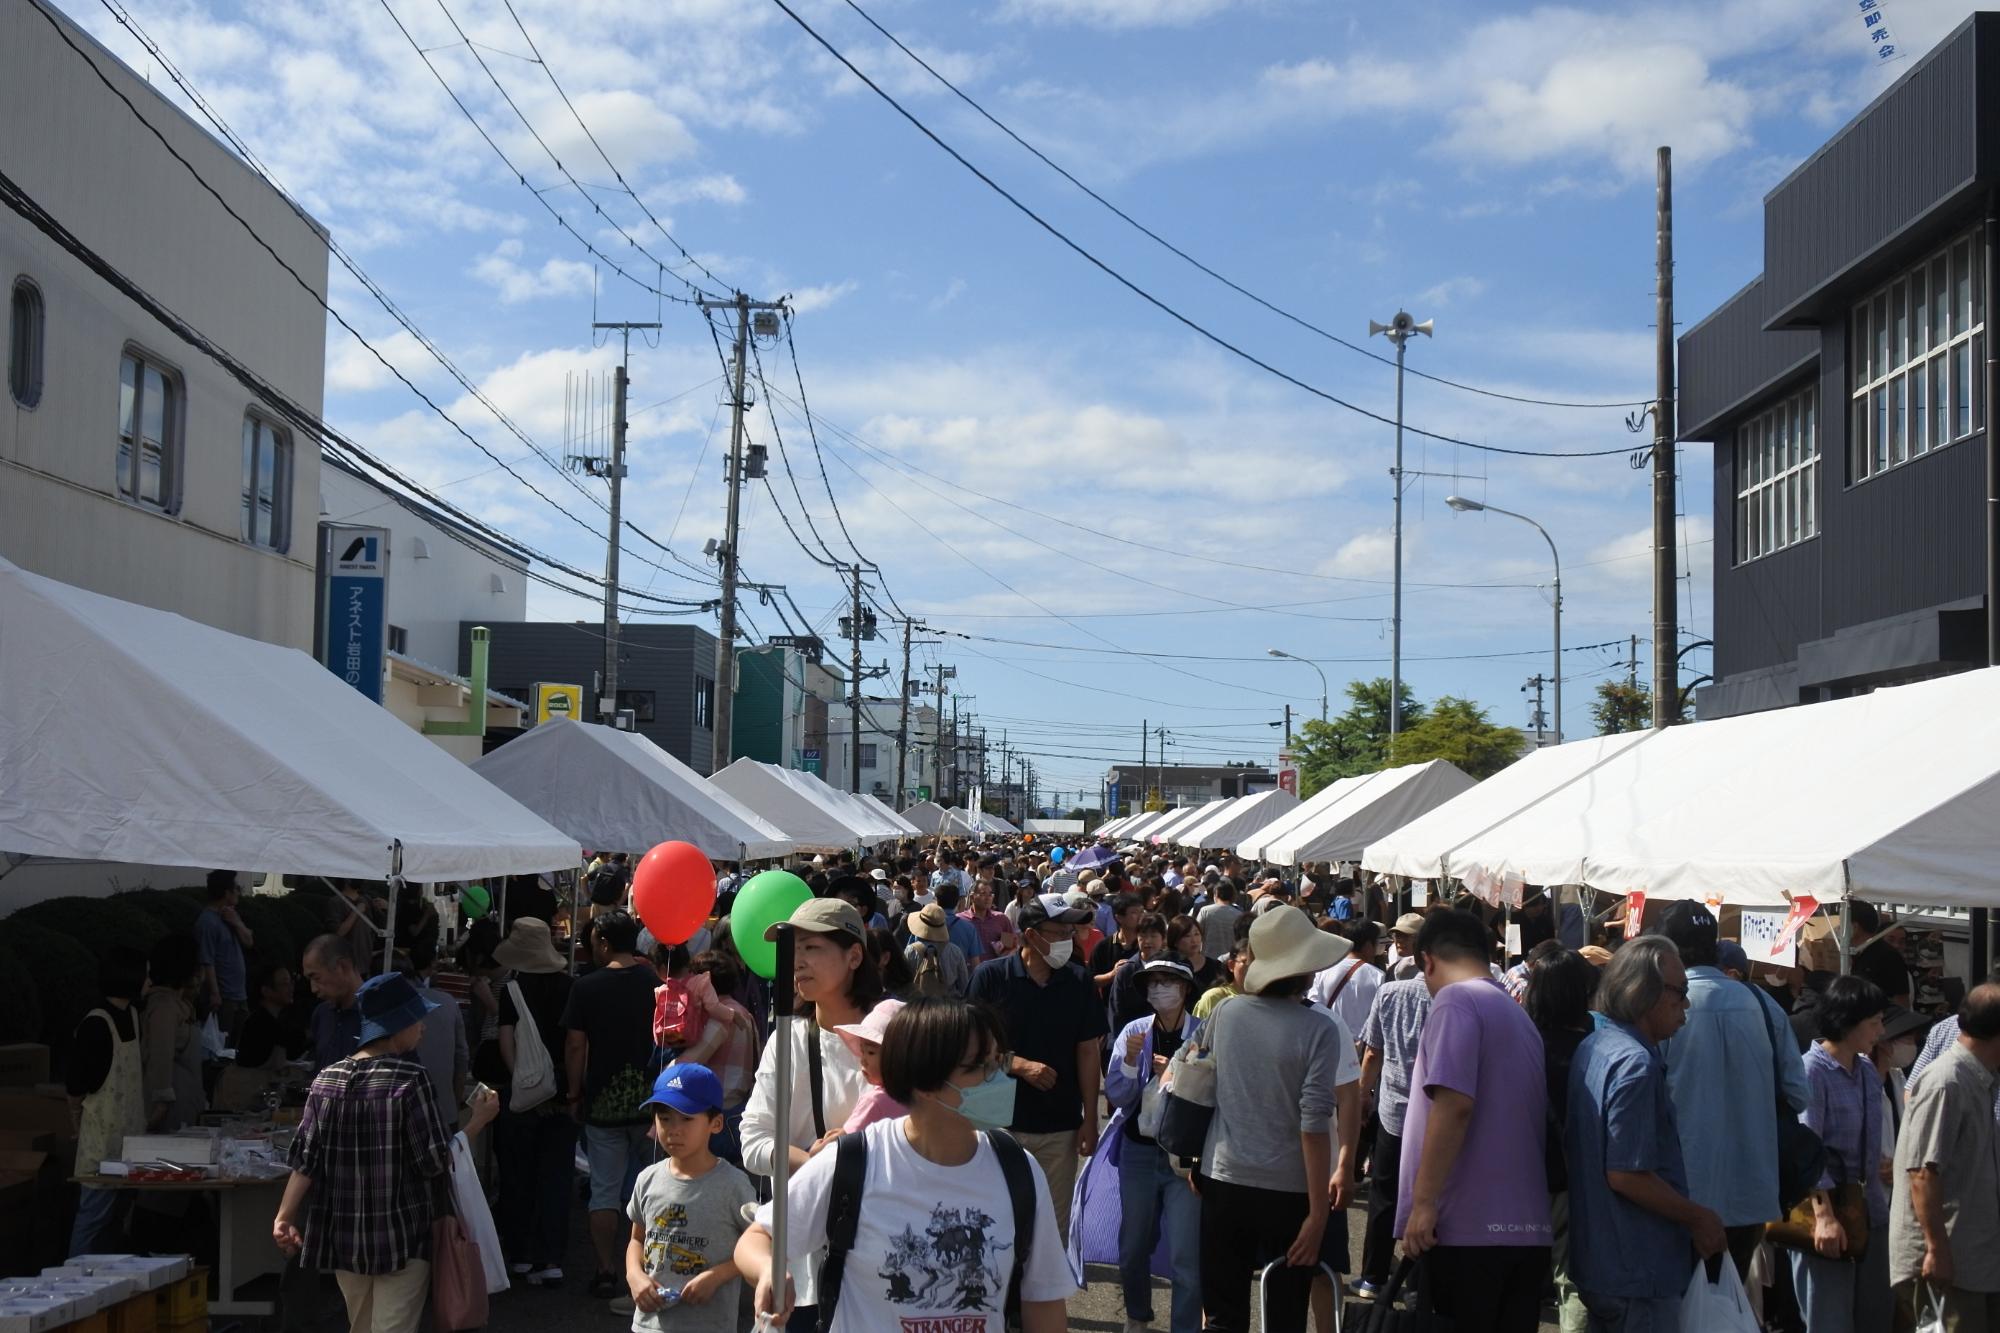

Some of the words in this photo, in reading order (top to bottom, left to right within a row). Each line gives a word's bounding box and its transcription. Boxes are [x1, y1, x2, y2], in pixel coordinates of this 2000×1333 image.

[346, 586, 363, 690] アネスト岩田の
[1487, 1223, 1506, 1233] YOU
[901, 1318, 987, 1333] STRANGER
